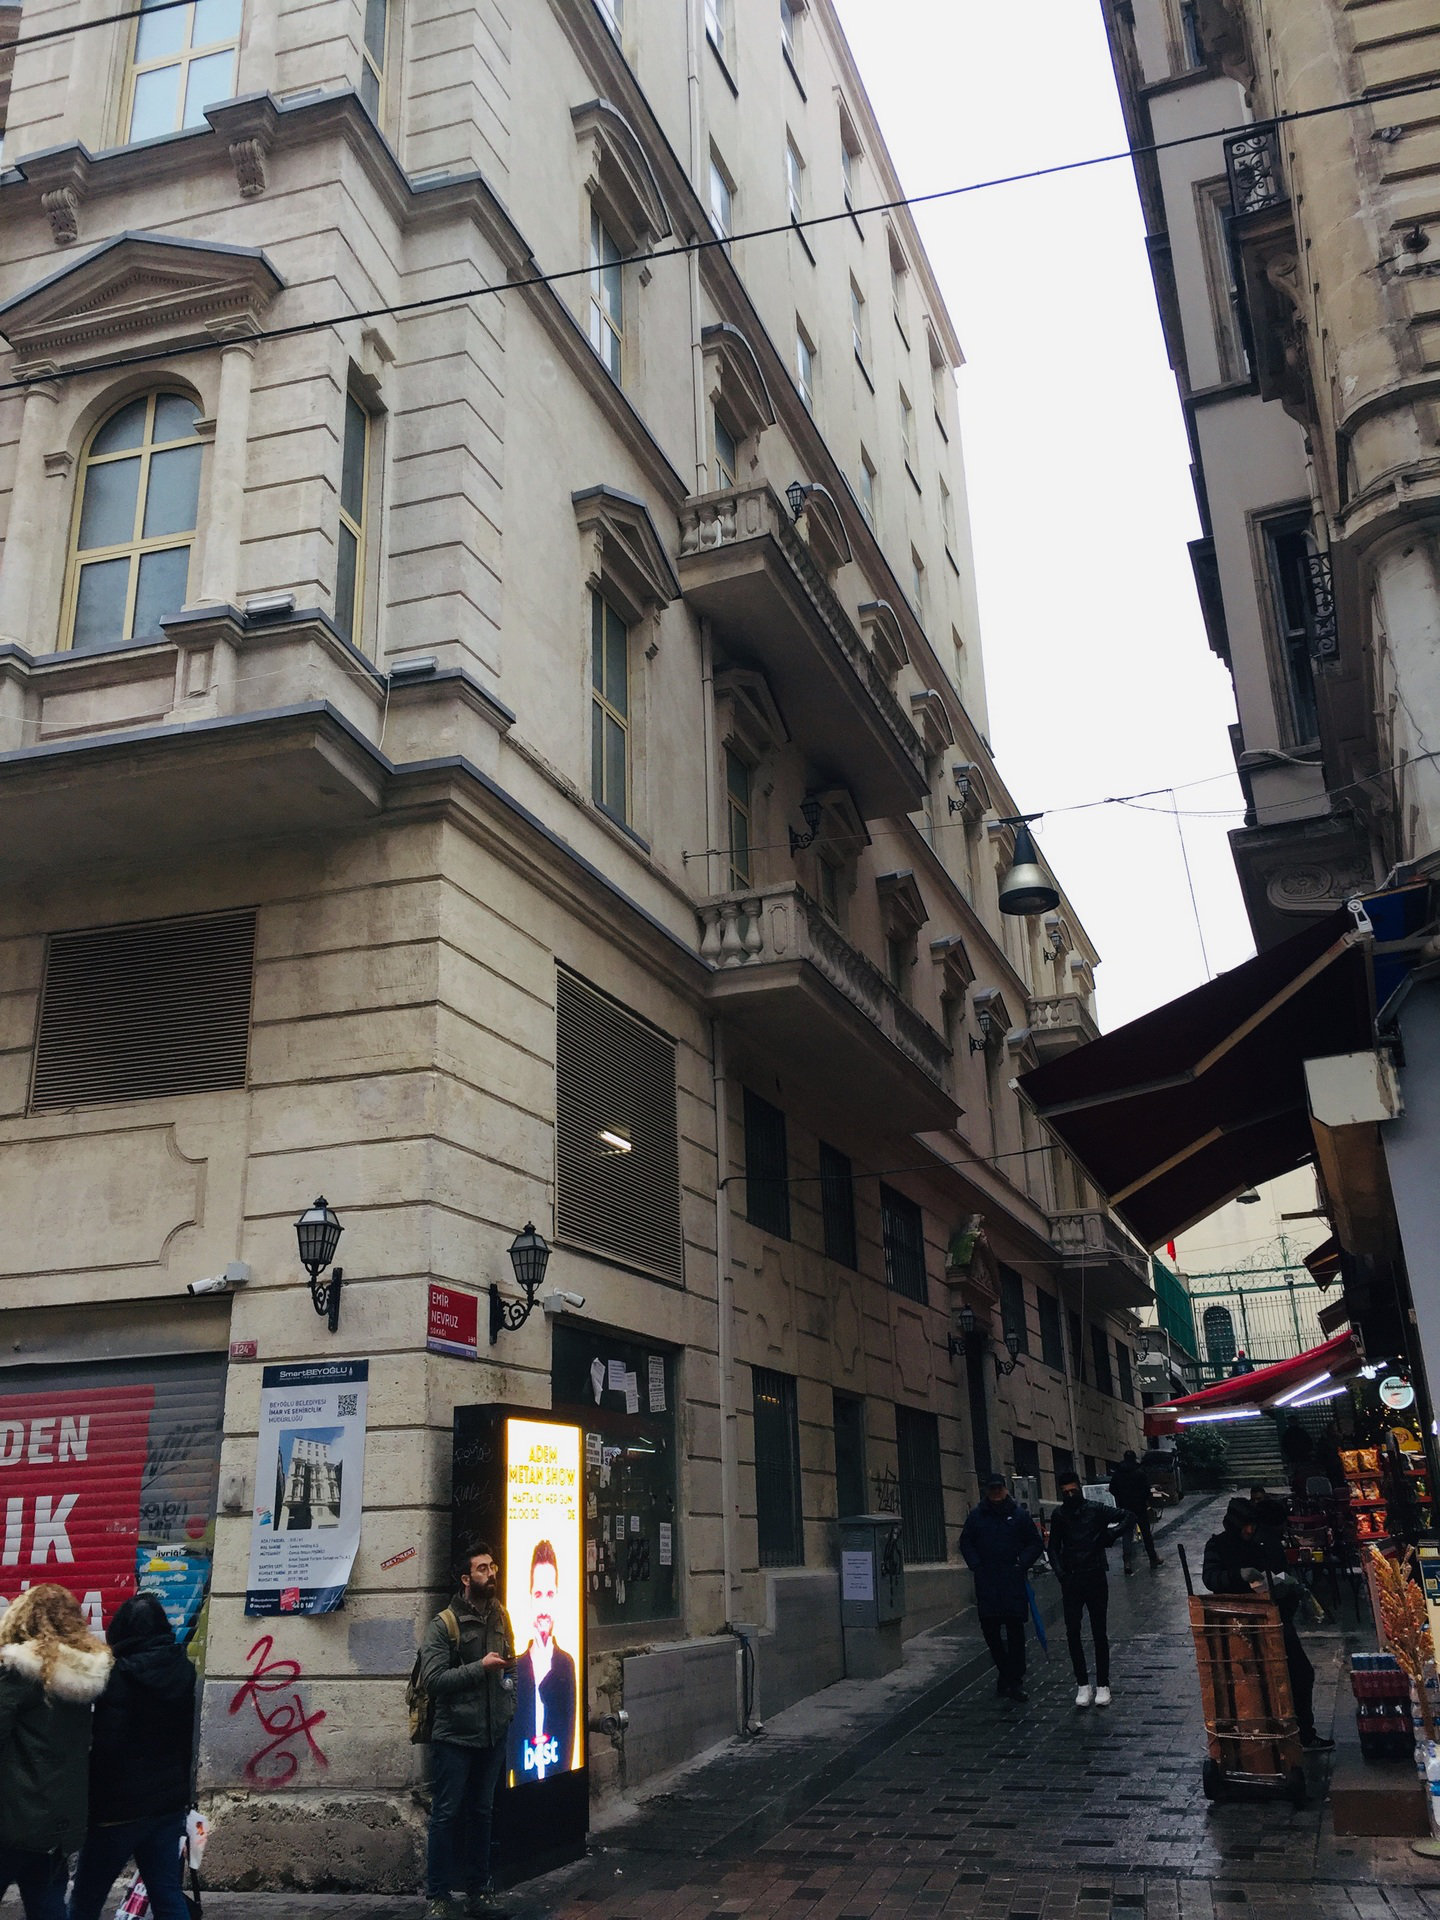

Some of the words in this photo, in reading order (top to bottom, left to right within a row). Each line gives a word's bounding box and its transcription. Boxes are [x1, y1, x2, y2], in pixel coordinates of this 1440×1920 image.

[432, 1292, 449, 1308] EMİR
[431, 1310, 459, 1329] NEVRUZ
[0, 1415, 91, 1466] DEN
[529, 1445, 558, 1464] ADEM
[508, 1464, 544, 1485] METAN
[545, 1467, 576, 1486] SHOW
